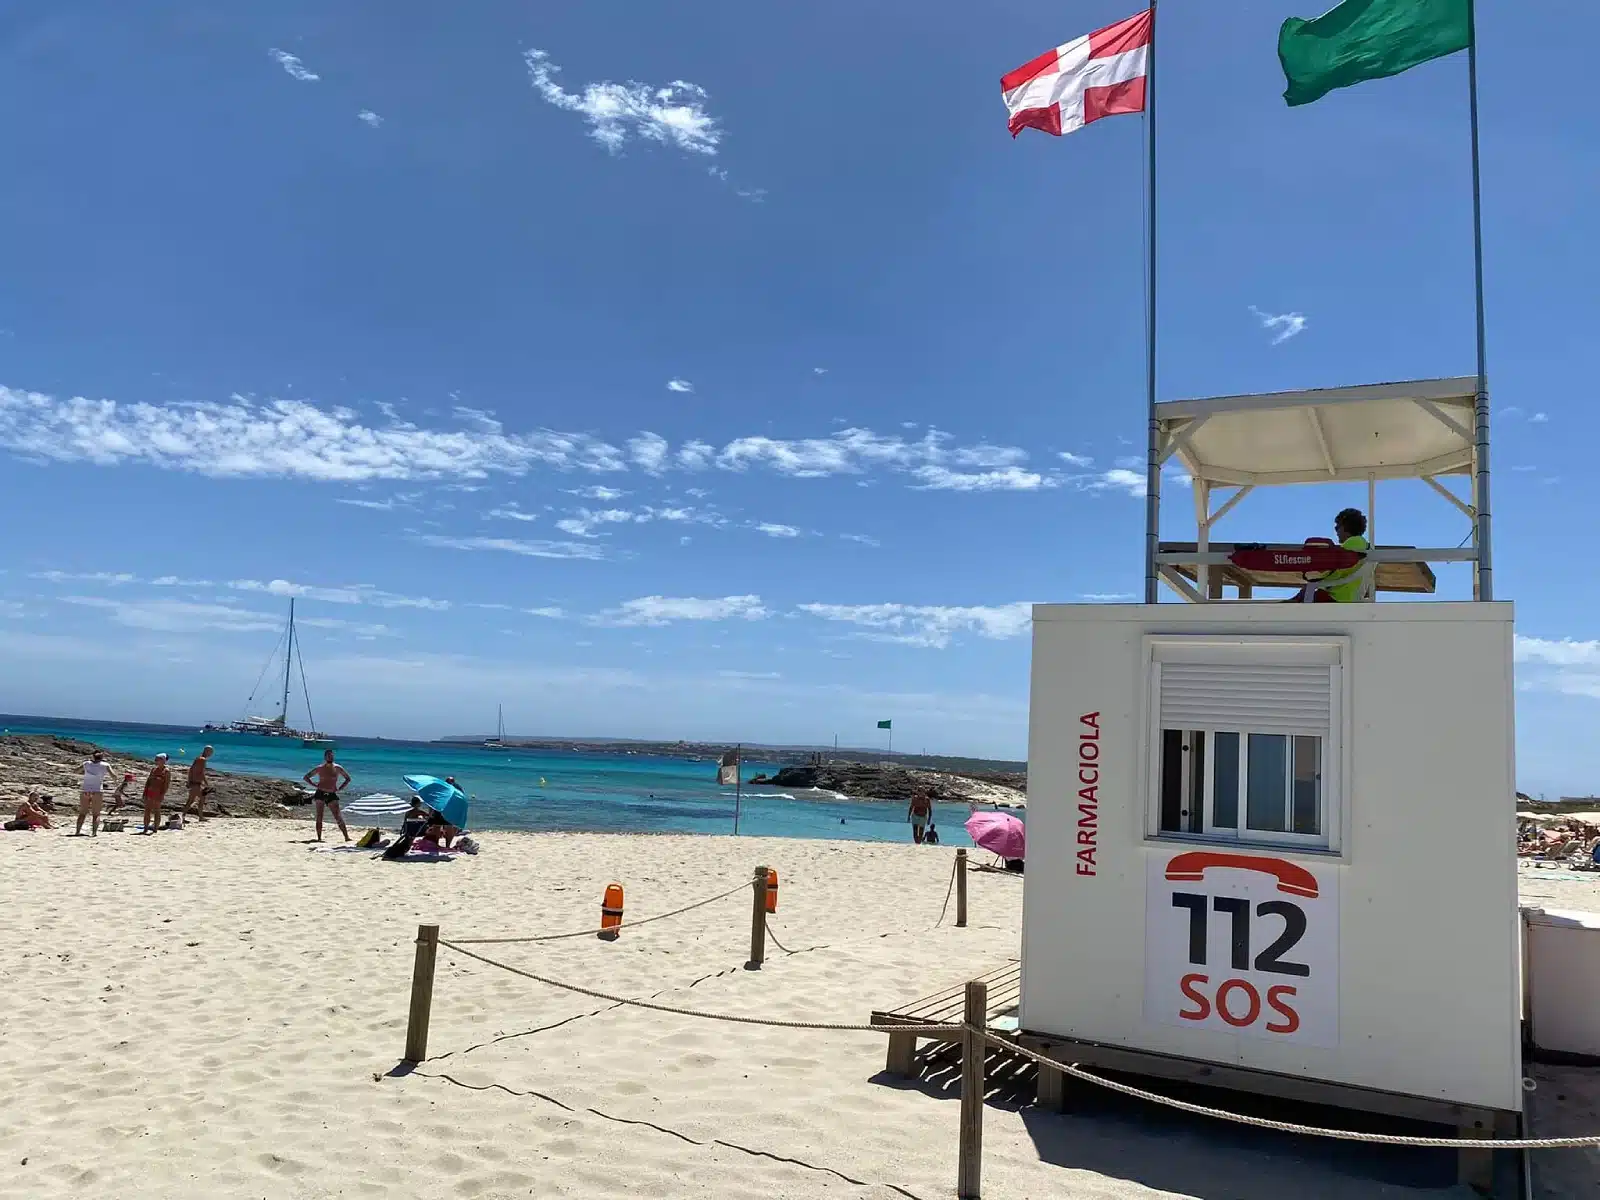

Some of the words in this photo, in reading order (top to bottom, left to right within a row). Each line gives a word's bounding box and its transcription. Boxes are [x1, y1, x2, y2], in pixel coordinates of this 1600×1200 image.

[1274, 554, 1312, 564] SLRescue
[1076, 711, 1101, 877] FARMACIOLA
[1172, 892, 1310, 977] 112
[1179, 973, 1300, 1034] SOS
